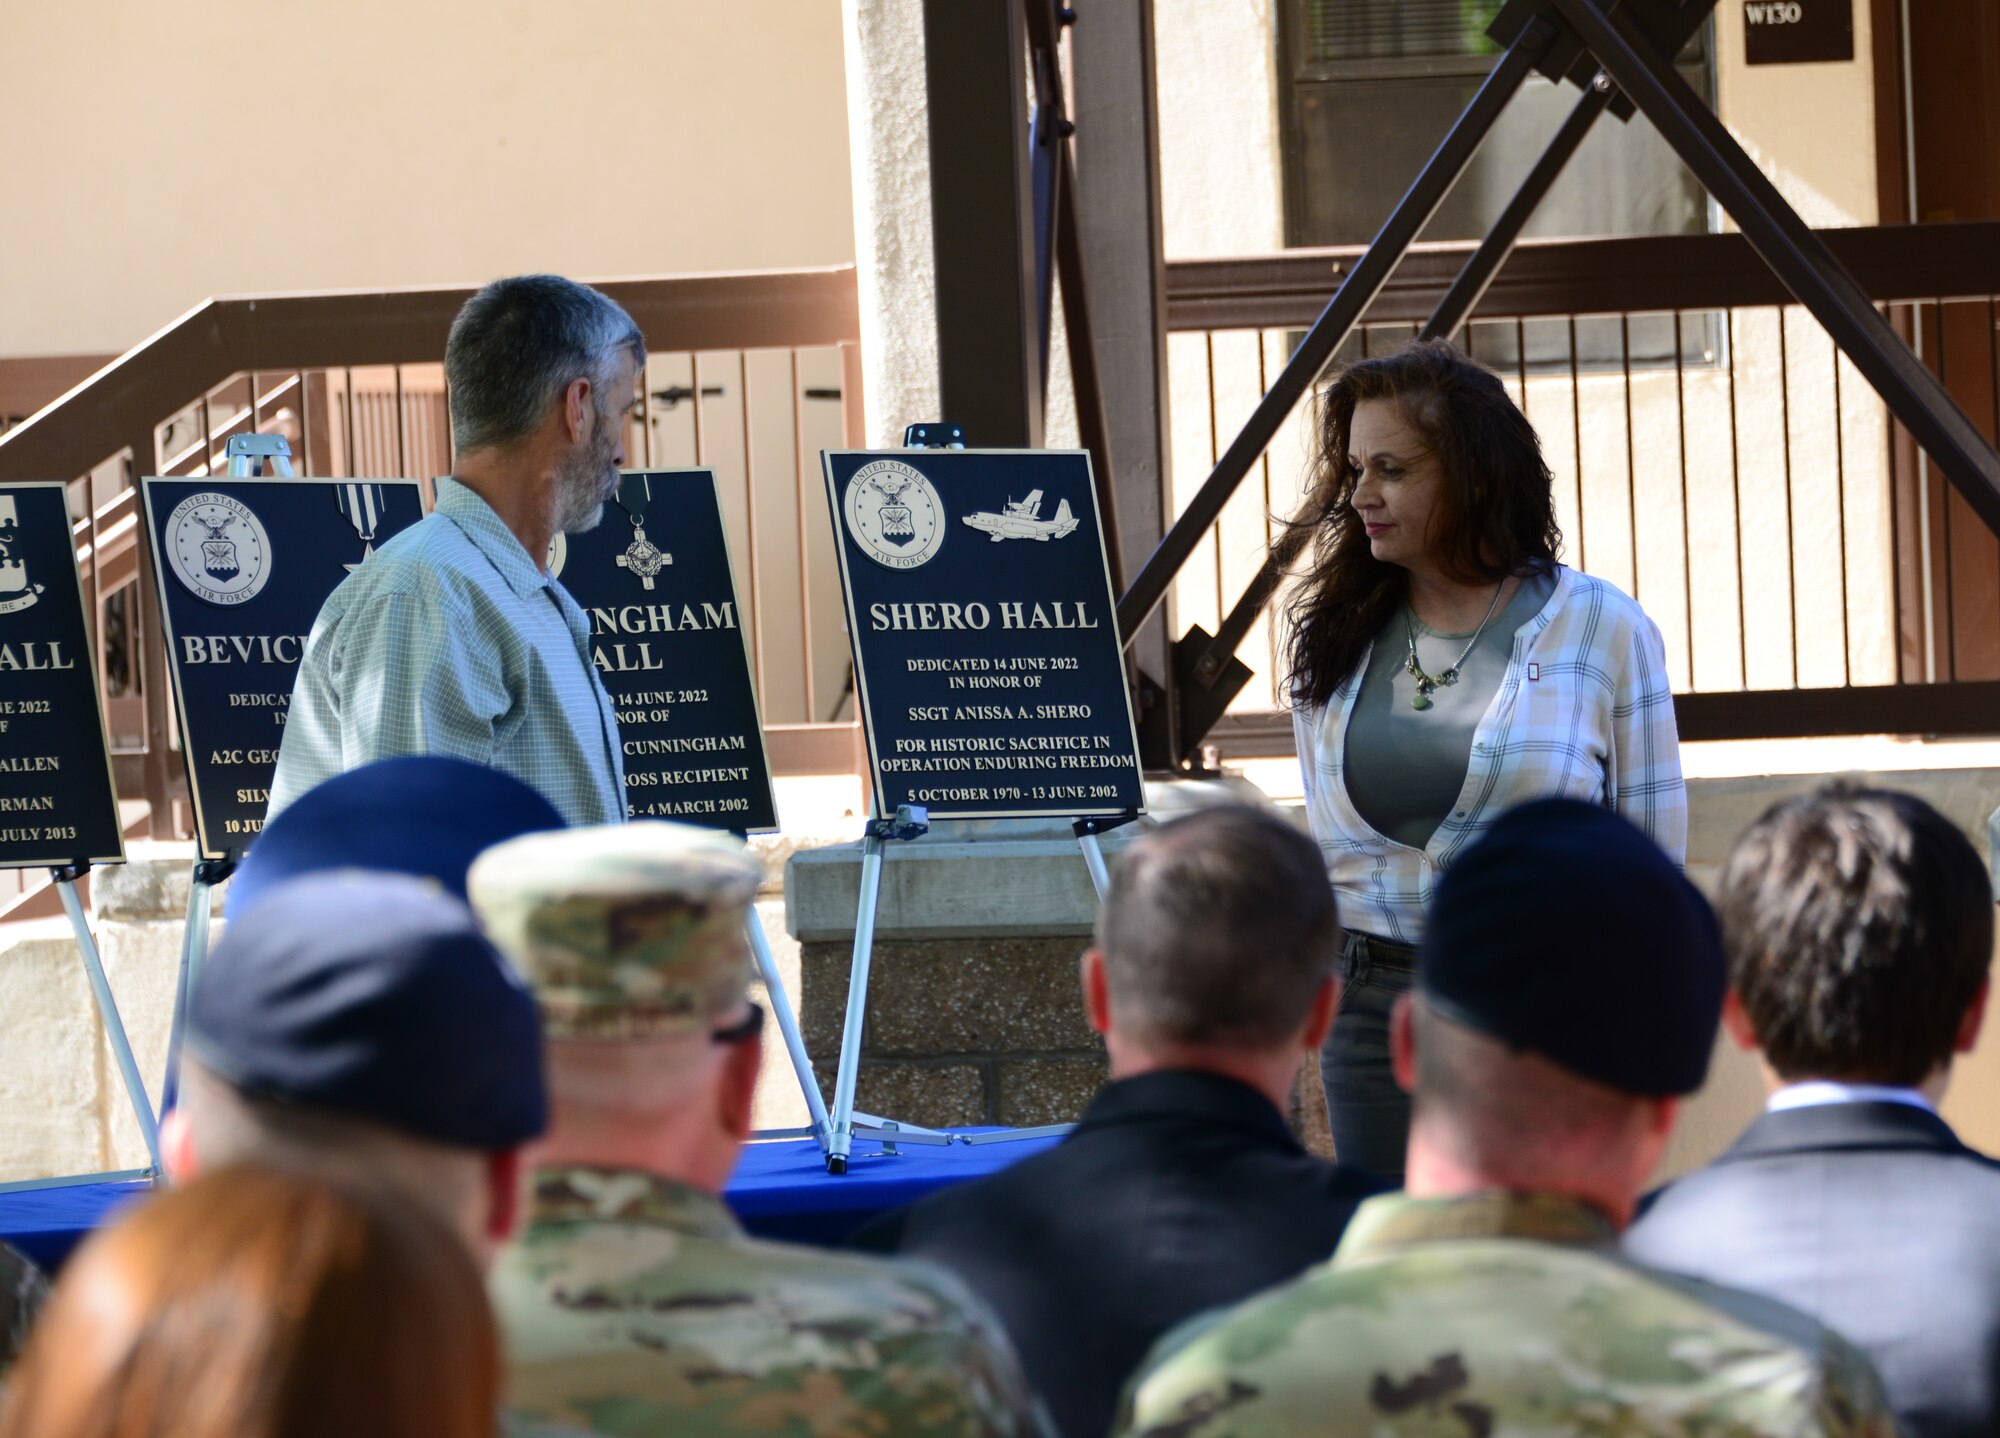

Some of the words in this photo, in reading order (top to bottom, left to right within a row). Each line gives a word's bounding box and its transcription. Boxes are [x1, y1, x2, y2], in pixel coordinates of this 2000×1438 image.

[1746, 1, 1802, 24] W130
[852, 461, 886, 486] UNITED
[890, 461, 926, 485] STATES
[173, 494, 209, 519] UNITED
[213, 494, 252, 520] STATES
[873, 552, 891, 564] AIR
[897, 552, 930, 567] FORCE
[195, 587, 214, 601] AIR
[220, 587, 255, 603] FORCE
[870, 602, 990, 631] SHERO
[998, 602, 1099, 630] HALL
[181, 635, 309, 664] BEVIC
[907, 658, 990, 672] DEDICATED
[994, 658, 1006, 671] 14
[1009, 657, 1046, 671] JUNE
[1050, 657, 1078, 670] 2022
[949, 676, 965, 689] IN
[969, 676, 1021, 689] HONOR
[1023, 675, 1042, 688] OF
[618, 694, 633, 706] 14
[635, 691, 676, 705] JUNE
[678, 690, 709, 703] 2022
[18, 700, 50, 714] 2022
[909, 706, 949, 721] SSGT
[954, 705, 1013, 720] ANISSA
[1018, 706, 1033, 719] A.
[1036, 705, 1091, 719] SHERO
[650, 709, 670, 723] OF
[623, 736, 746, 756] CUNNINGHAM
[896, 739, 928, 753] FOR
[930, 737, 1005, 752] HISTORIC
[1009, 736, 1090, 750] SACRIFICE
[1094, 736, 1110, 749] IN
[211, 750, 243, 764] A2C
[880, 757, 971, 772] OPERATION
[975, 756, 1057, 770] ENDURING
[1060, 755, 1135, 768] FREEDOM
[661, 767, 749, 785] RECIPIENT
[908, 789, 916, 801] 5
[918, 788, 990, 801] OCTOBER
[993, 787, 1021, 799] 1970
[1032, 786, 1045, 799] 13
[1048, 786, 1086, 799] JUNE
[1089, 785, 1118, 798] 2002
[647, 803, 655, 816] 4
[658, 800, 715, 815] MARCH
[719, 798, 749, 811] 2002
[0, 828, 40, 842] JULY
[44, 826, 76, 840] 2013
[225, 820, 239, 833] 10
[242, 819, 265, 833] JU
